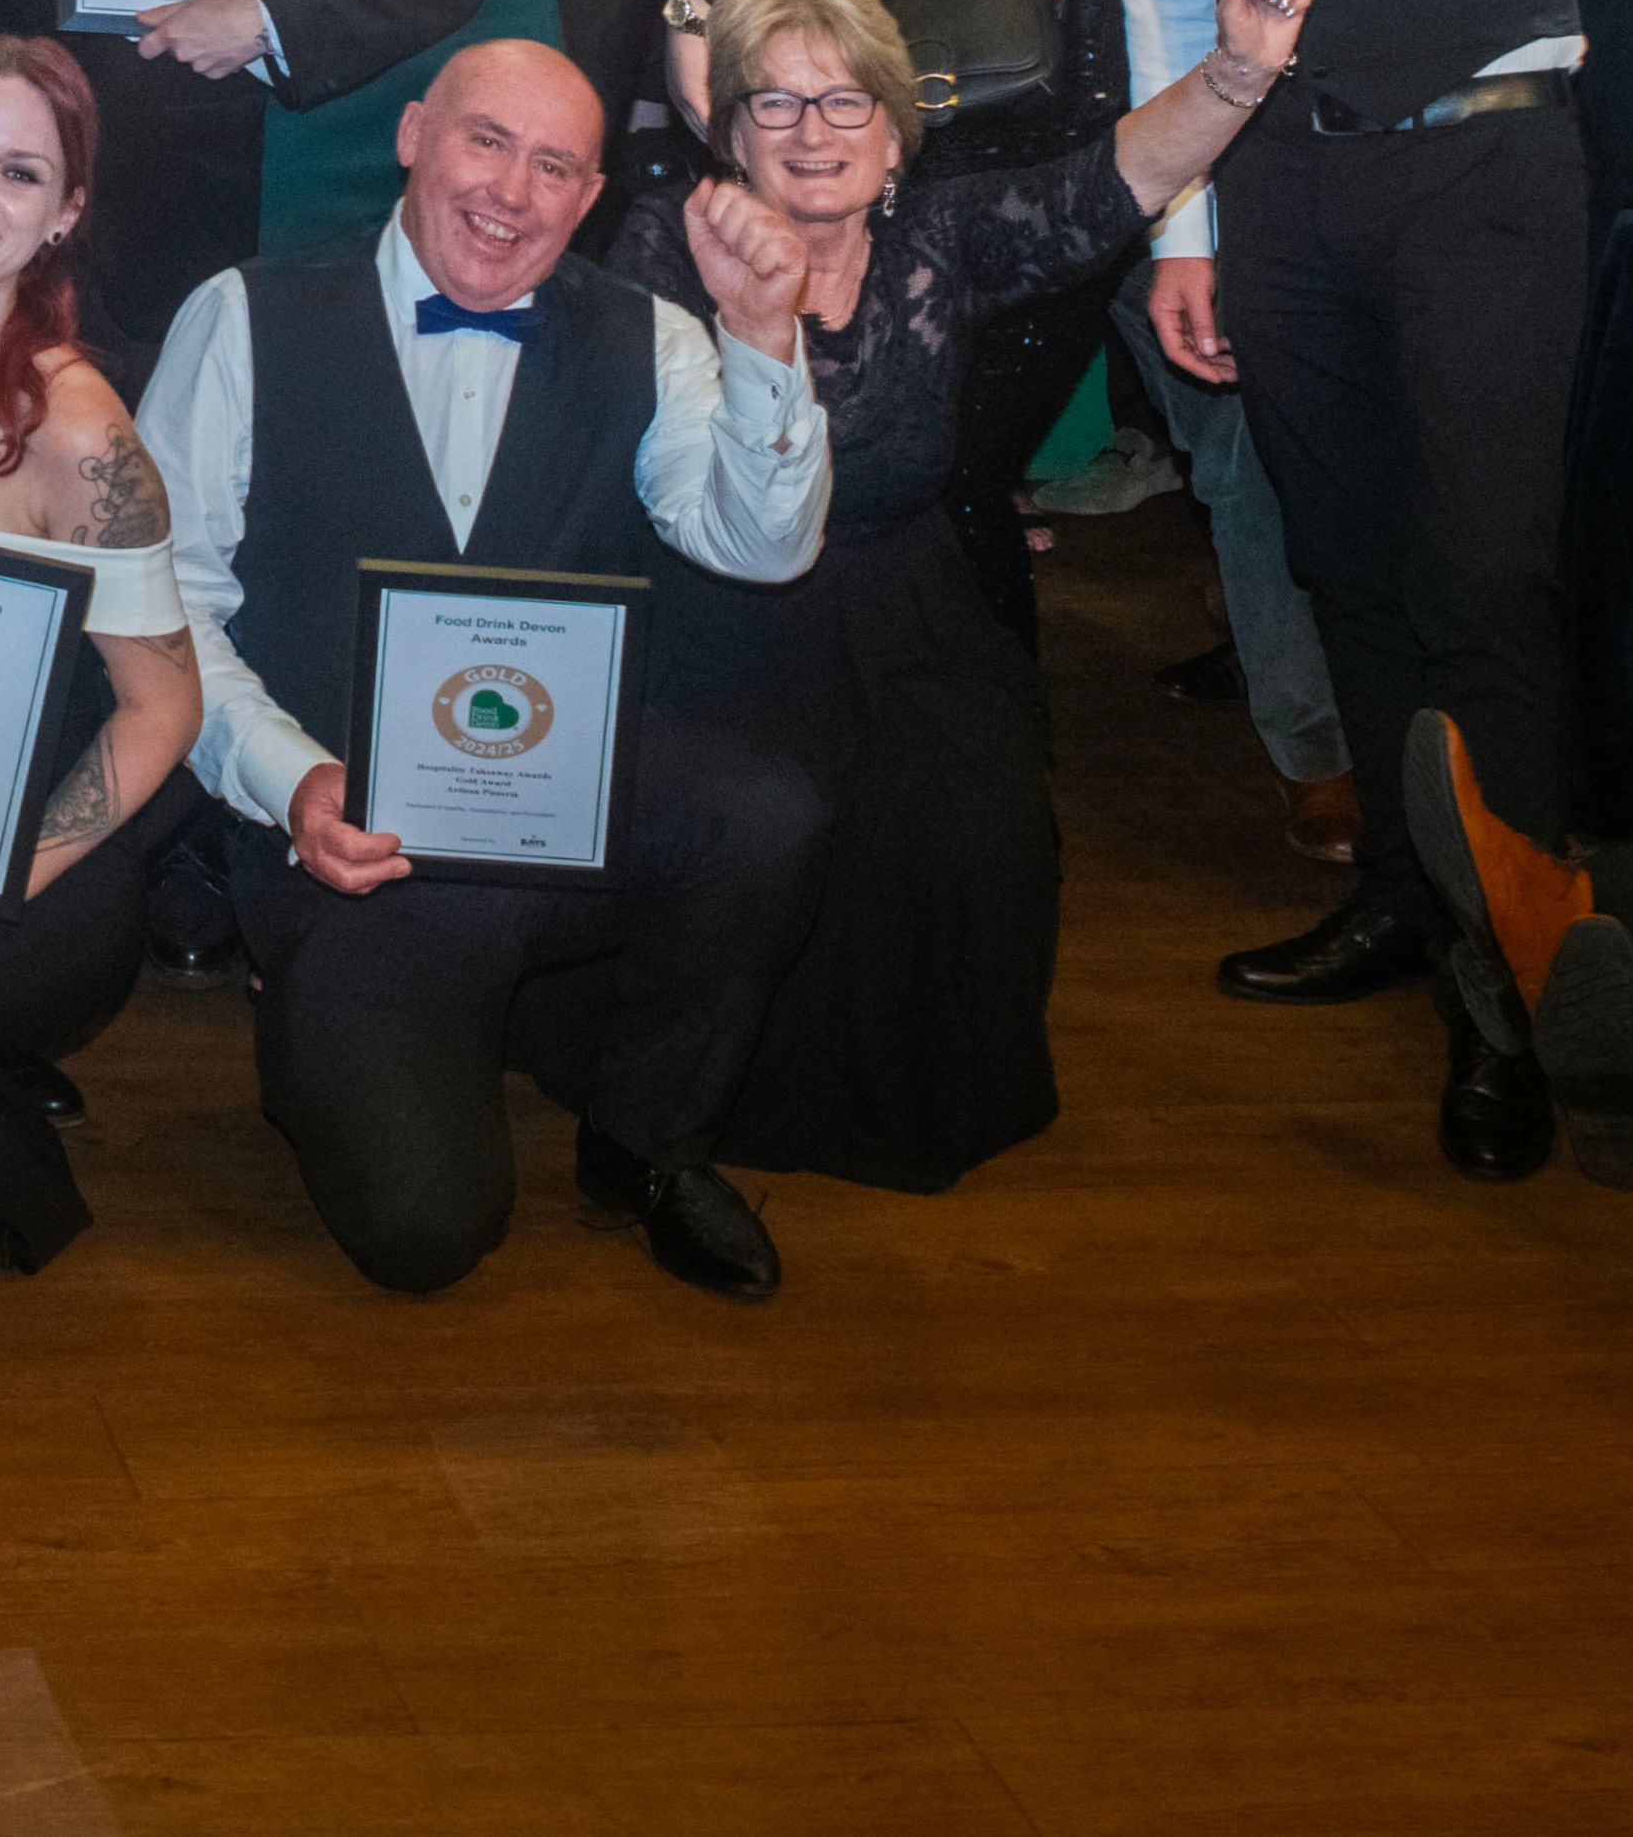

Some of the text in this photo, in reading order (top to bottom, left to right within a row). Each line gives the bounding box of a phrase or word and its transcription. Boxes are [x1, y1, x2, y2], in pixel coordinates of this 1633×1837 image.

[436, 614, 566, 634] Food Drink Devon
[470, 633, 527, 647] Awards
[464, 667, 527, 686] GOLD
[456, 735, 525, 755] 2024/25
